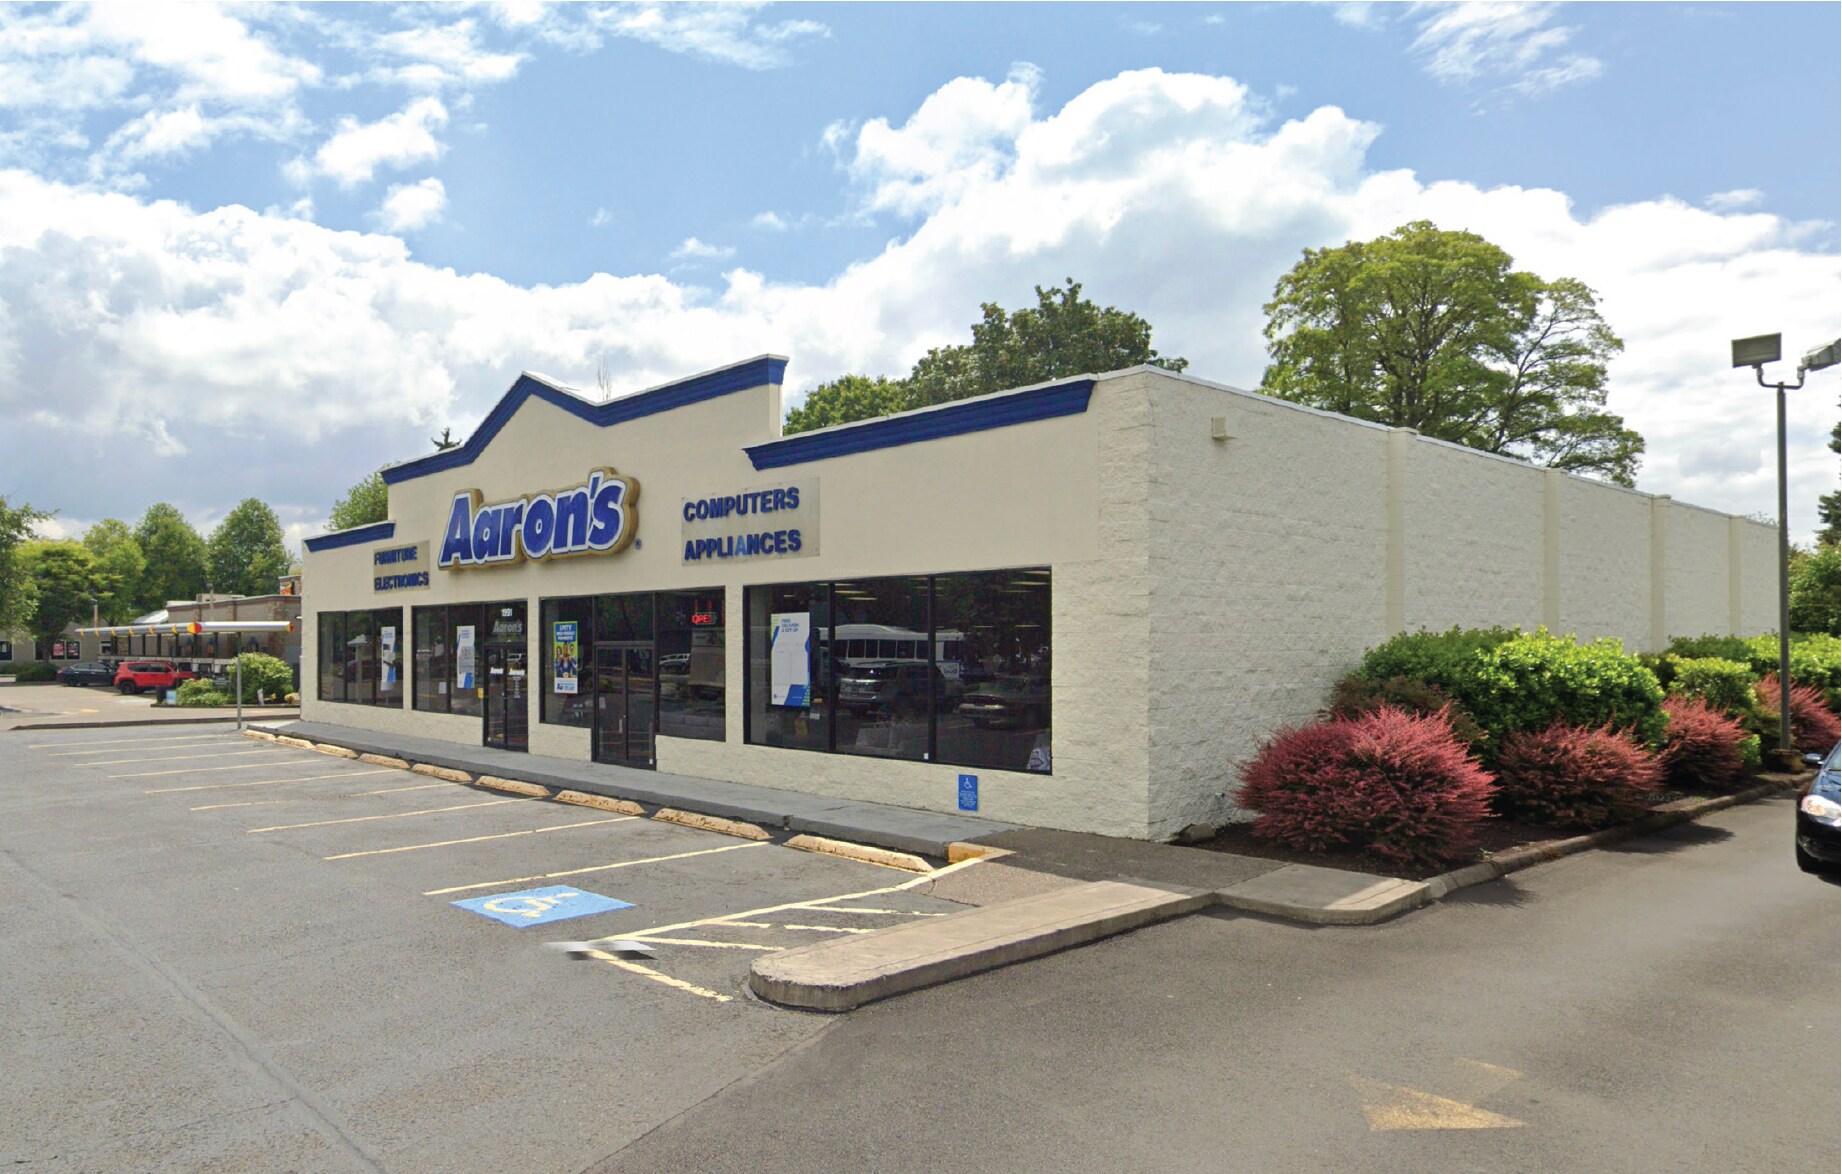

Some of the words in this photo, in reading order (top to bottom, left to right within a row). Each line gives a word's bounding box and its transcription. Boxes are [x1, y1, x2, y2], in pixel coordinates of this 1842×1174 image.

[438, 470, 626, 567] Aaron's
[683, 487, 800, 522] COMPUTERS
[684, 529, 802, 560] APPLIANCES
[374, 571, 429, 591] ELECTRONICS
[493, 620, 523, 633] Aaron's
